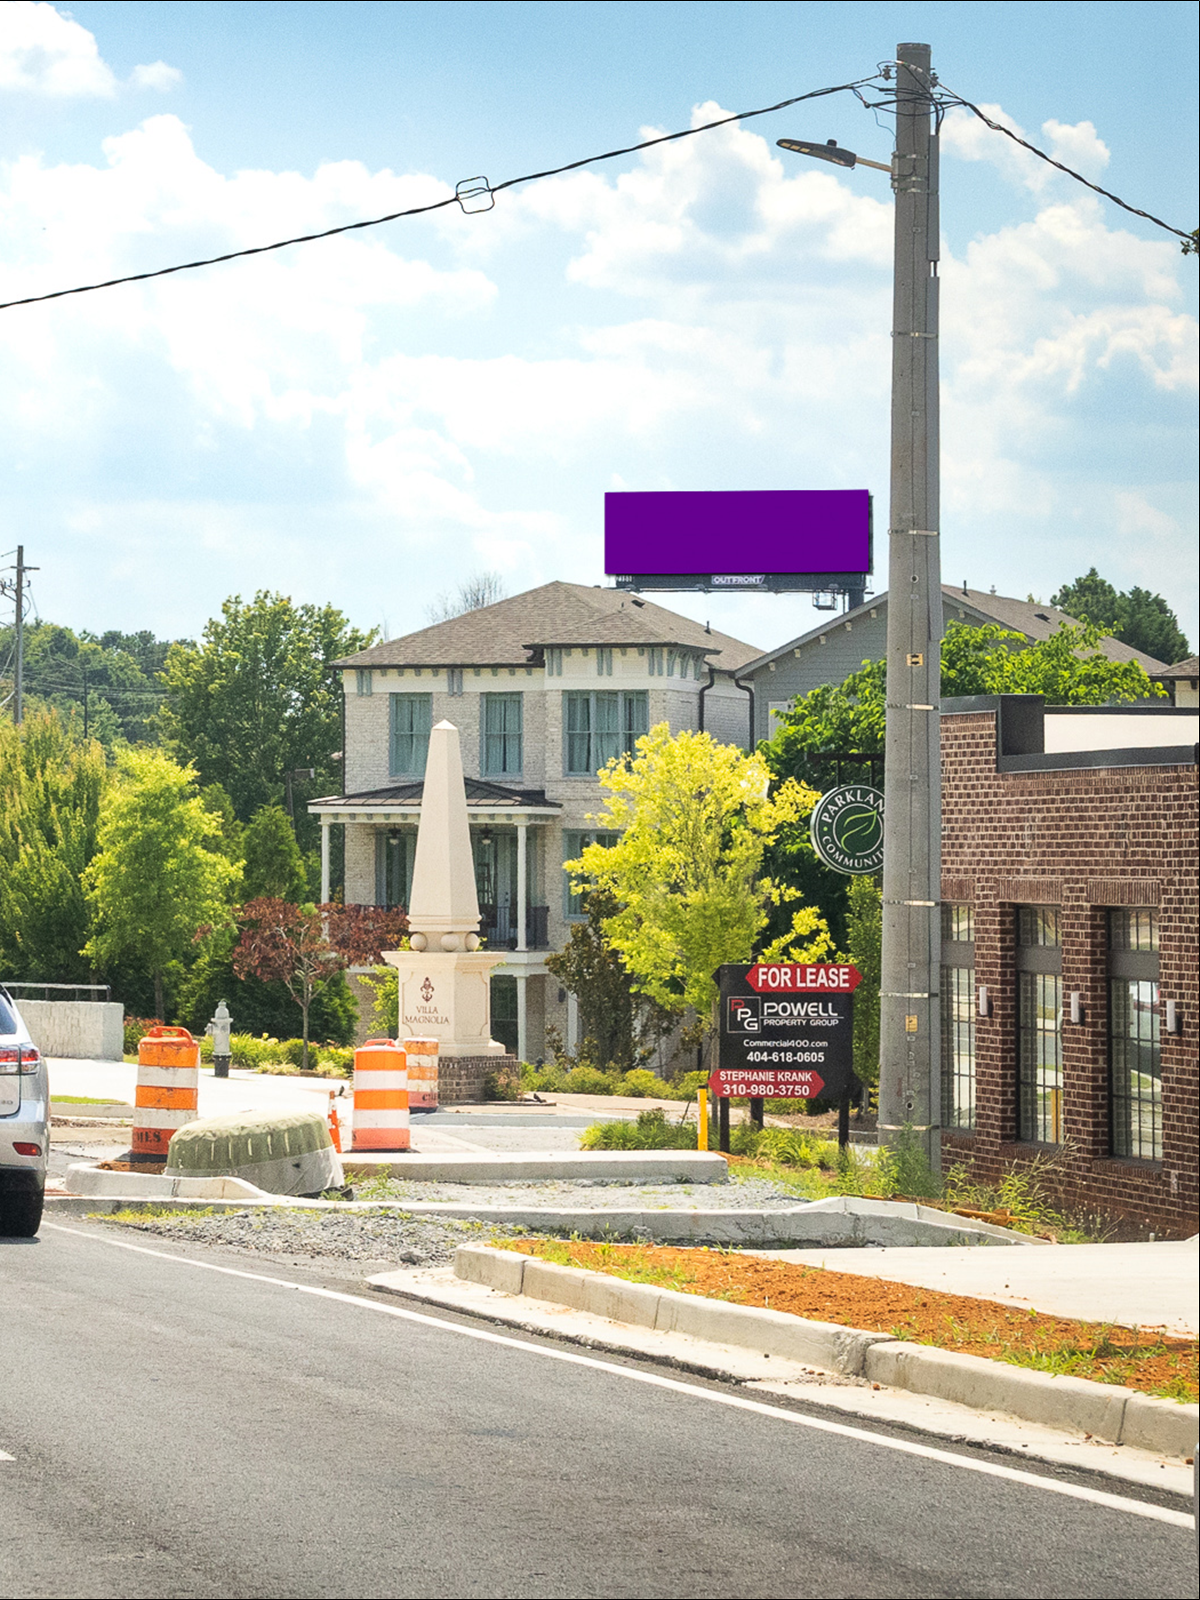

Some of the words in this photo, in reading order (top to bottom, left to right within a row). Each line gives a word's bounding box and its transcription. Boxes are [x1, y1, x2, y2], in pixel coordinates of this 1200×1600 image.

[713, 576, 761, 584] OUTFRONT
[821, 790, 885, 823] PARKLAN
[758, 967, 792, 987] FOR
[796, 967, 849, 987] LEASE
[416, 1005, 439, 1014] VILLA
[764, 1002, 838, 1016] POWELL
[405, 1015, 449, 1024] MAGNOLIA
[763, 1018, 806, 1026] PROPERTY
[810, 1018, 839, 1026] GROUP
[743, 1039, 828, 1047] Commercial400.com
[747, 1051, 825, 1062] 404-618-0605
[719, 1071, 775, 1081] STEPHANIE
[777, 1072, 813, 1082] KRANK
[722, 1084, 810, 1096] 310-980-3750
